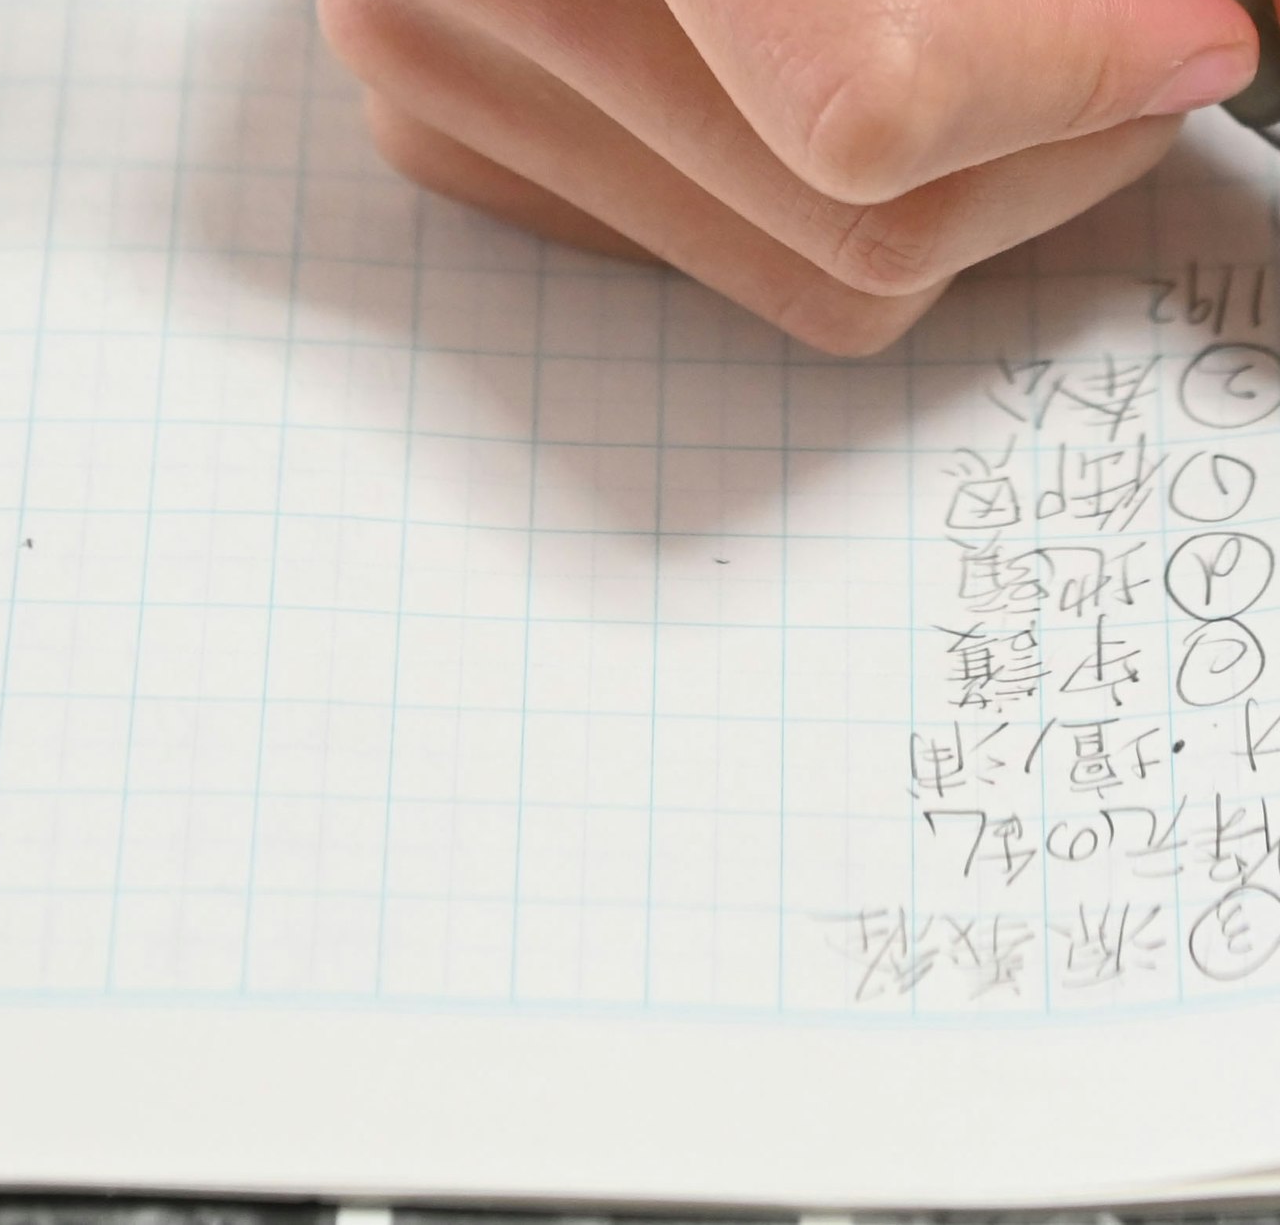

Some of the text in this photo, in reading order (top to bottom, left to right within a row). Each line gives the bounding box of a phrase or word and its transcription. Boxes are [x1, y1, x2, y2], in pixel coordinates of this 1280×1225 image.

[1130, 260, 1266, 337] 1192
[982, 353, 1162, 443] 奉公
[937, 433, 1168, 534] 御恩
[945, 534, 1151, 620] 地頭
[929, 615, 1141, 715] 守護
